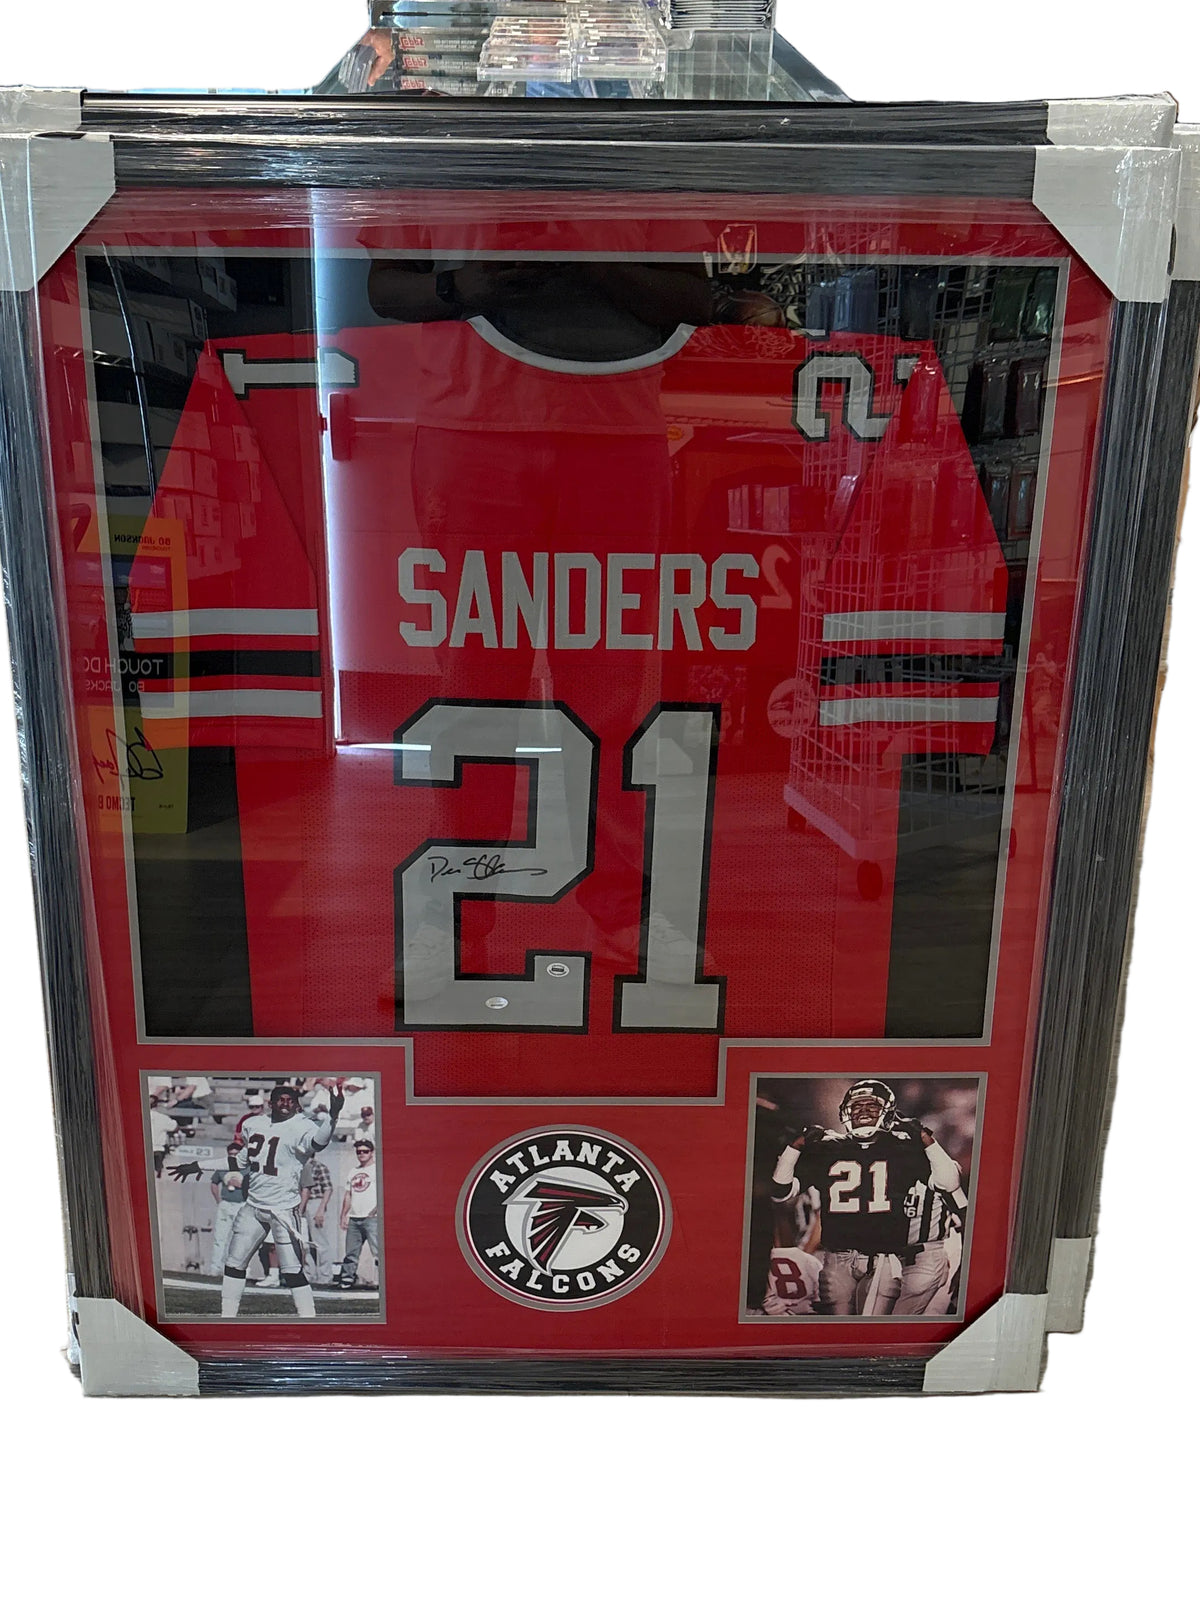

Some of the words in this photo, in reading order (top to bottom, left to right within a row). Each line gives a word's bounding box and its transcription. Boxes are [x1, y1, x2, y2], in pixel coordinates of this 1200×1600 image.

[397, 547, 760, 651] SANDERS
[393, 697, 728, 1034] 21
[247, 1132, 281, 1177] 21
[489, 1139, 641, 1194] ATLANTA
[827, 1159, 892, 1214] 21
[485, 1240, 642, 1294] FALCONS
[770, 1257, 808, 1300] 8
